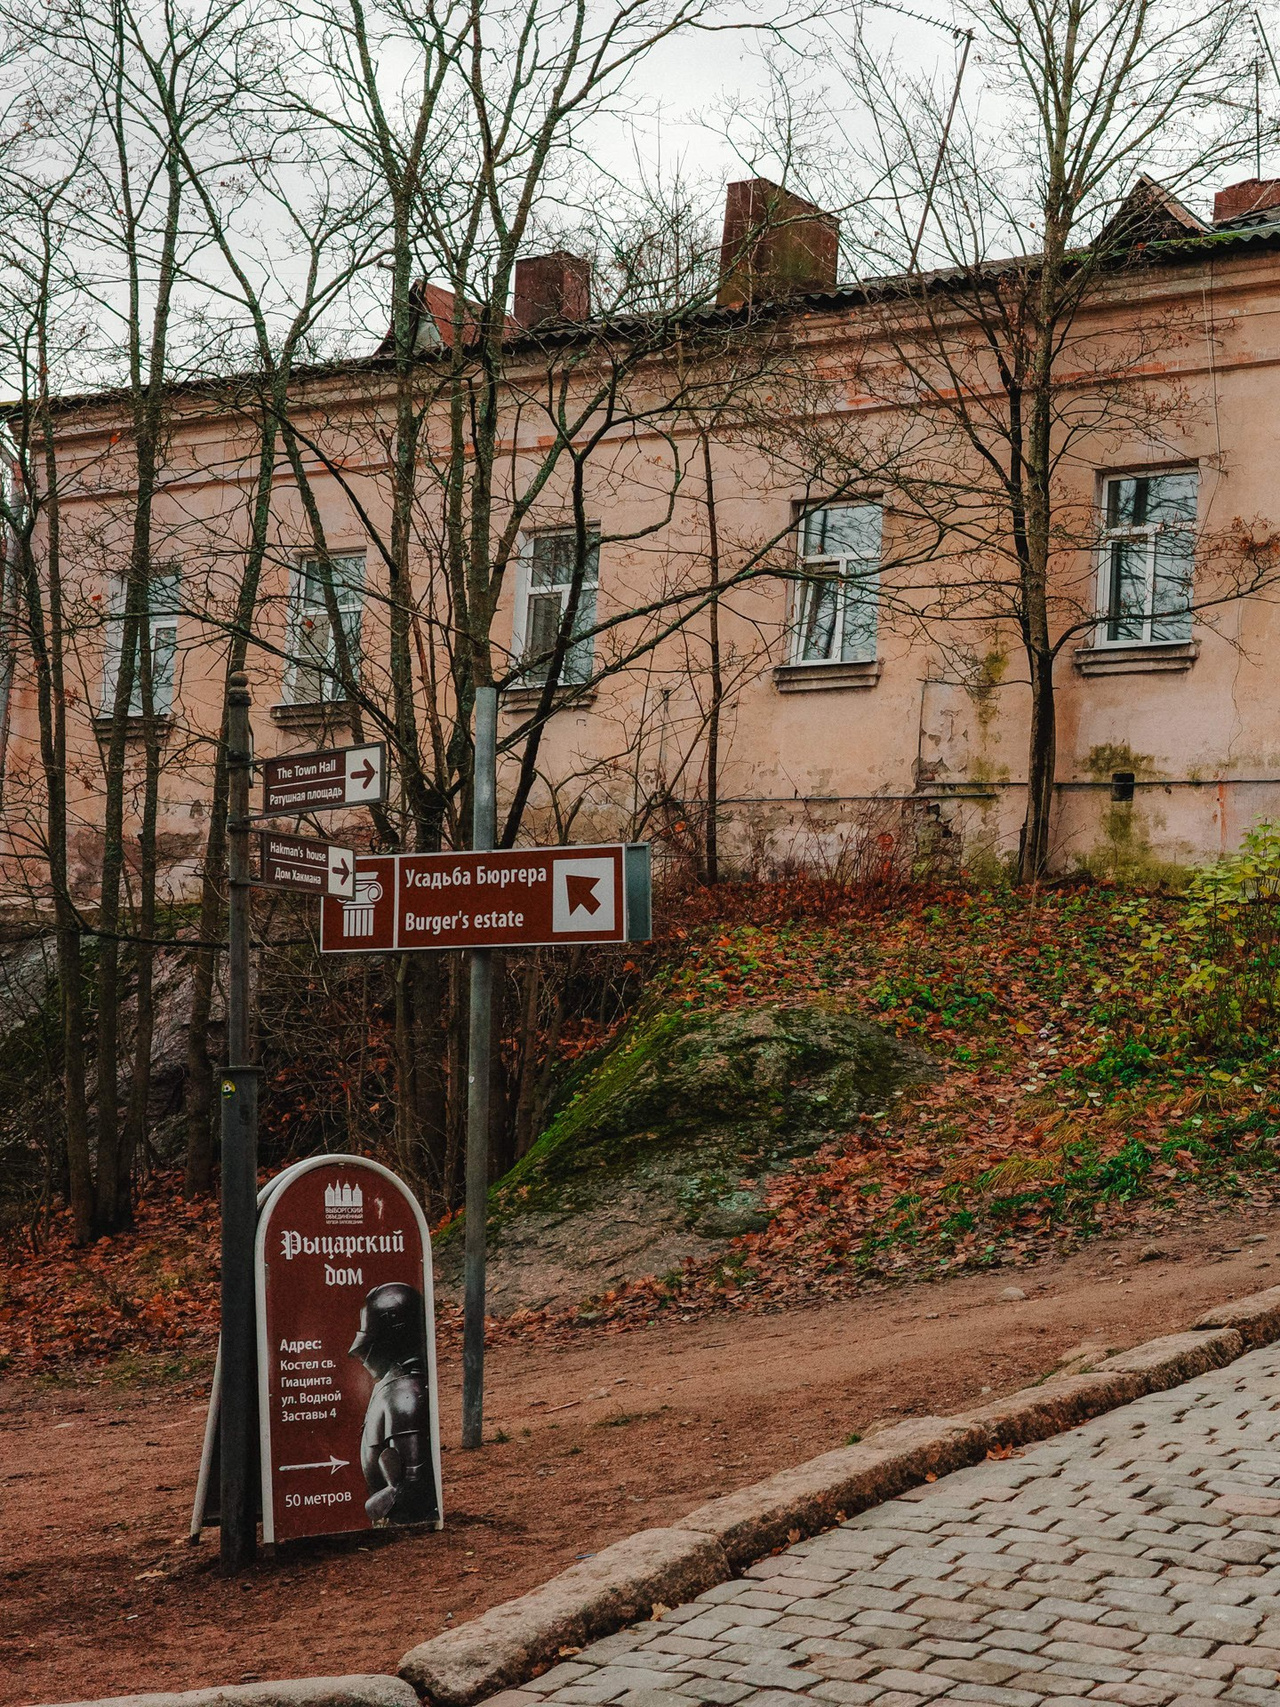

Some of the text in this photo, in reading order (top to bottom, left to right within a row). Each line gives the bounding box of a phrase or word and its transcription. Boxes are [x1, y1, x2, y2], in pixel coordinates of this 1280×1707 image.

[277, 759, 336, 779] The Town Hall
[269, 787, 343, 807] Ратушная площадь
[270, 841, 326, 862] Hakman's house
[274, 867, 322, 885] Дом Хакмана
[405, 865, 547, 890] Усадьба Бюргера
[405, 910, 524, 935] Burger's estate
[280, 1229, 405, 1260] Рыцарский
[279, 1338, 322, 1354] Адрес:
[280, 1359, 336, 1371] Костел св.
[281, 1376, 332, 1388] Гиацинта
[281, 1390, 342, 1407] ул. Водной
[281, 1407, 337, 1422] Заставы 4
[285, 1490, 352, 1508] 50 метров
